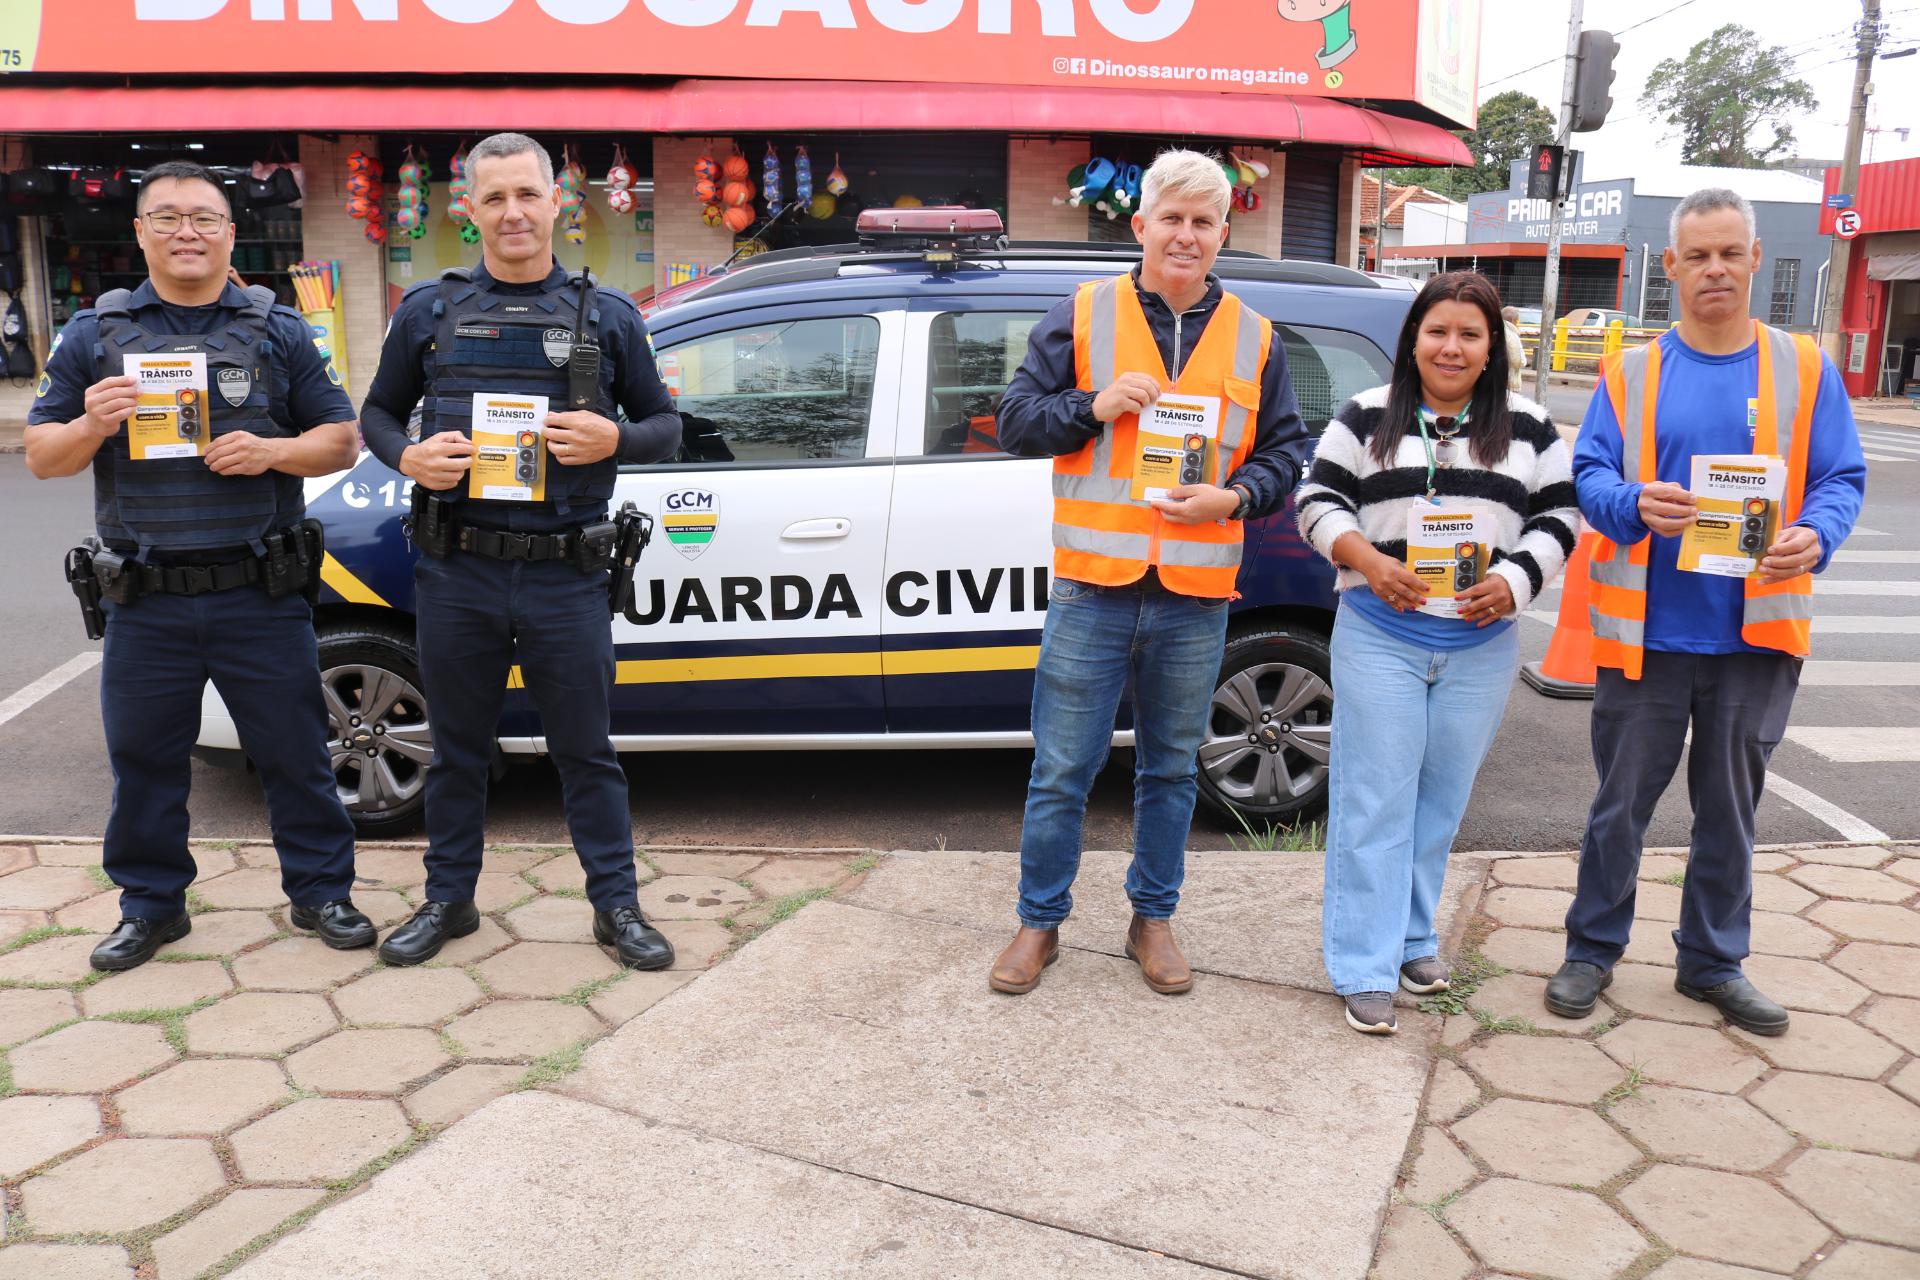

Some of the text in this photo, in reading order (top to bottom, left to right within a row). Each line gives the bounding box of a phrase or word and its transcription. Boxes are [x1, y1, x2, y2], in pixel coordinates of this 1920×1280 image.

[0, 49, 21, 66] 75
[1090, 59, 1309, 86] Dinossauro magazine
[1507, 190, 1622, 222] PRIMS CAR
[1525, 221, 1598, 238] AUTO ENTER
[547, 330, 571, 341] GCM
[139, 368, 193, 378] TRÂNSITO
[221, 370, 245, 380] GCM
[486, 408, 535, 419] TRÂNSITO
[1155, 409, 1204, 422] TRÂNSITO
[1708, 472, 1766, 485] TRÂNSITO
[379, 480, 416, 506] 15
[666, 491, 713, 509] GCM
[1422, 522, 1473, 531] TRÂNSITO
[624, 566, 1049, 626] UARDA CIVIL
